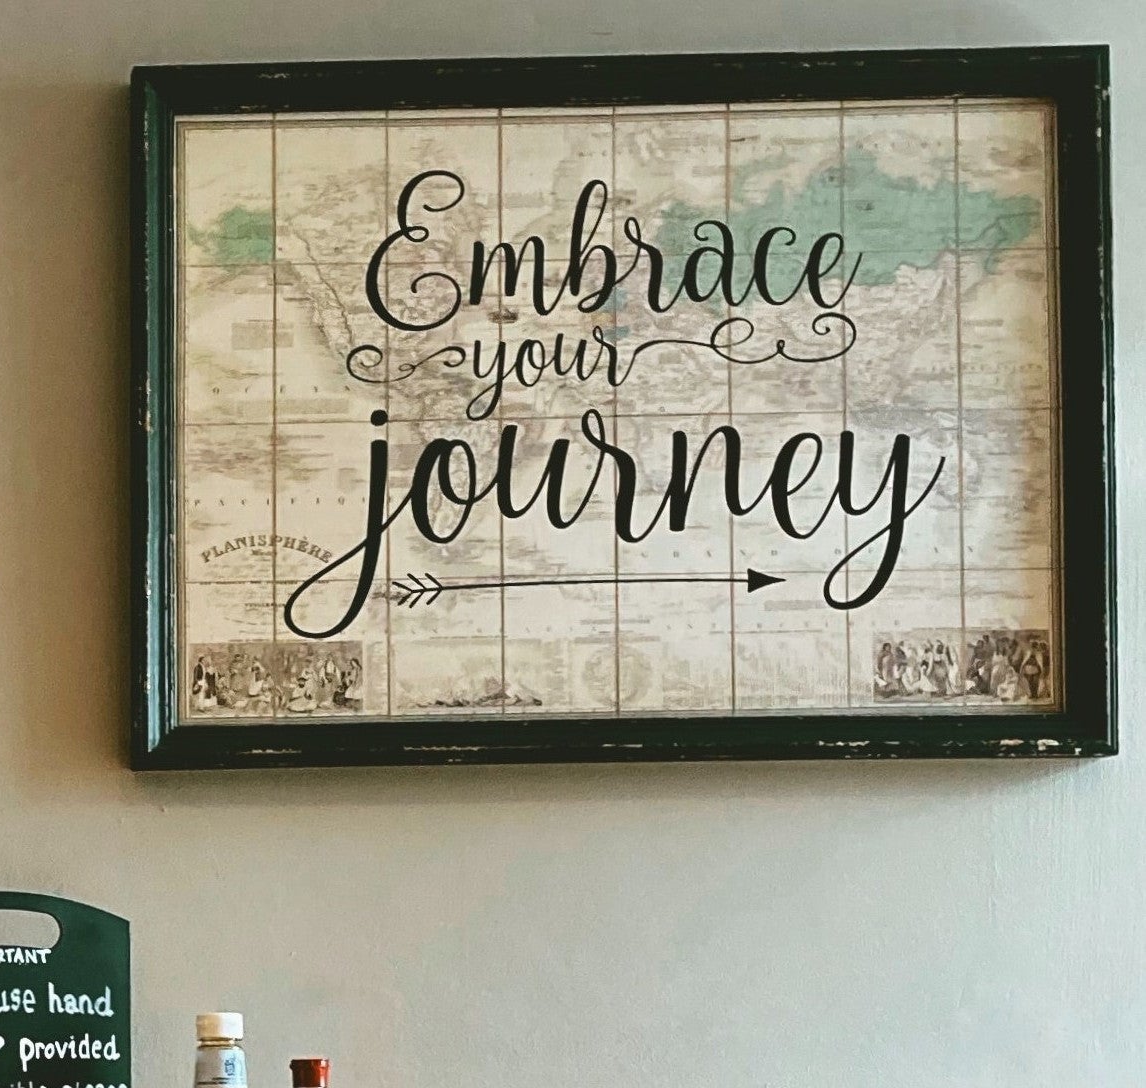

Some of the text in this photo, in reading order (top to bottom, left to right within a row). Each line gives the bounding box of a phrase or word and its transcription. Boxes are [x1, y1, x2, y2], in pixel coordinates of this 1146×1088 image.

[365, 169, 863, 332] Embrace
[283, 408, 946, 640] journey
[48, 981, 115, 1017] hand
[19, 1034, 121, 1072] provided
